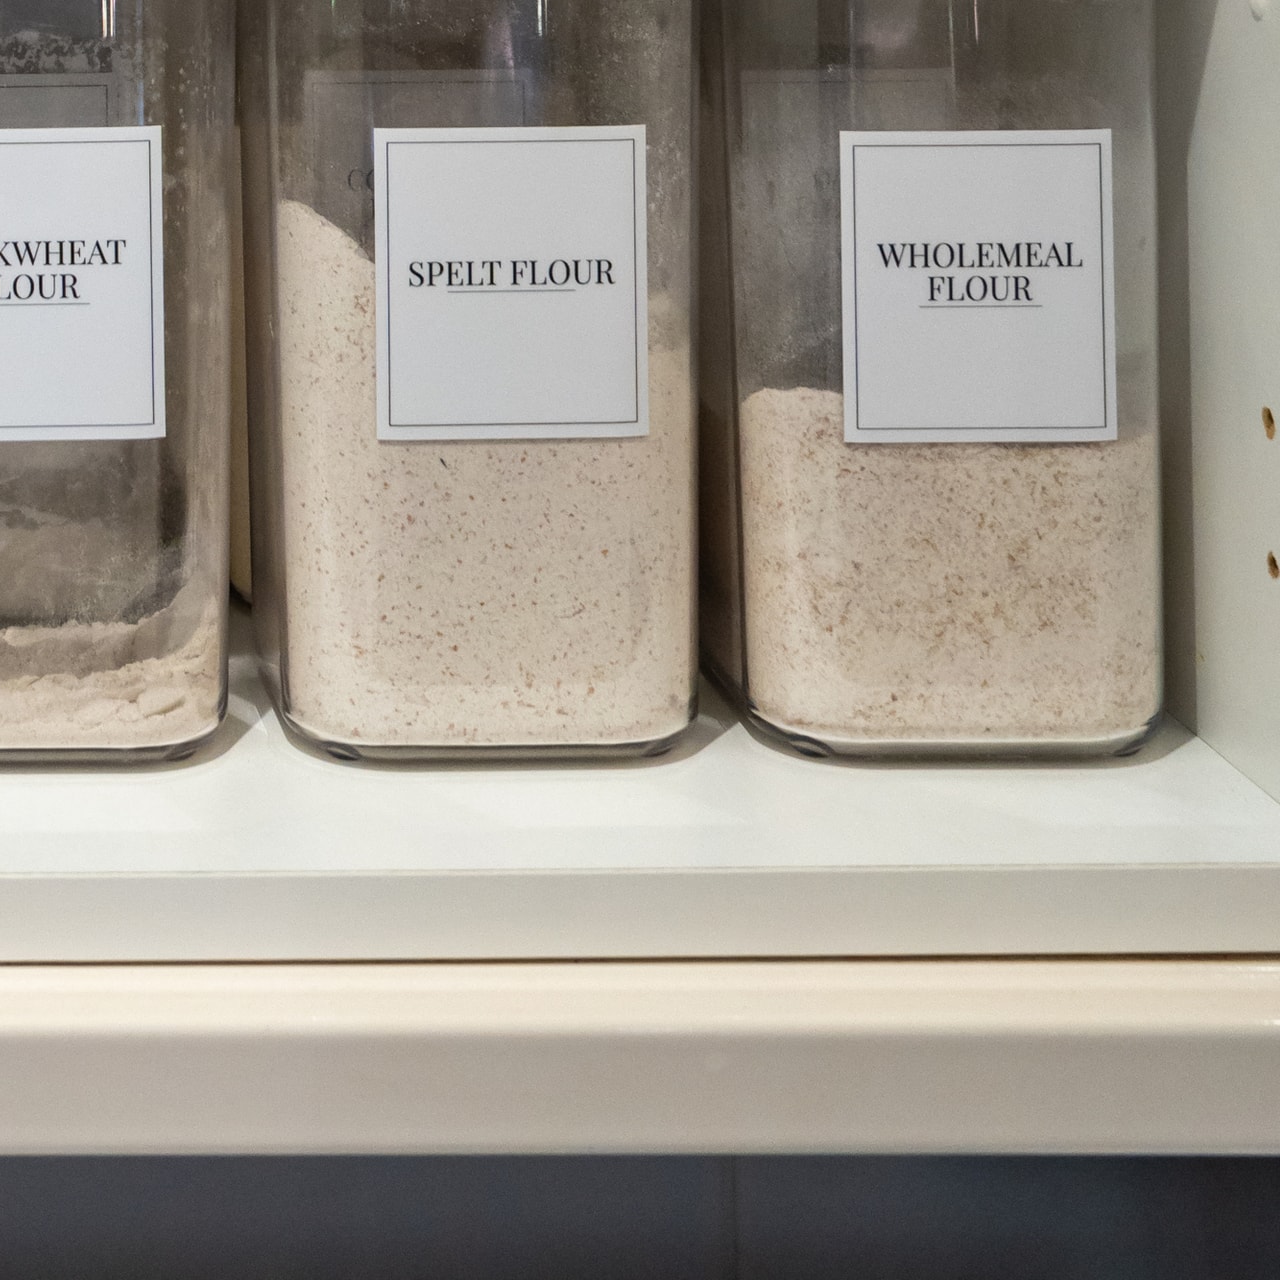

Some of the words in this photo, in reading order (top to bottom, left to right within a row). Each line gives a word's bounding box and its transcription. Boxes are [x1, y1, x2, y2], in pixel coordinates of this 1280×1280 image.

[876, 241, 1083, 269] WHOLEMEAL
[409, 260, 502, 287] SPELT
[510, 259, 615, 286] FLOUR
[928, 275, 1033, 302] FLOUR
